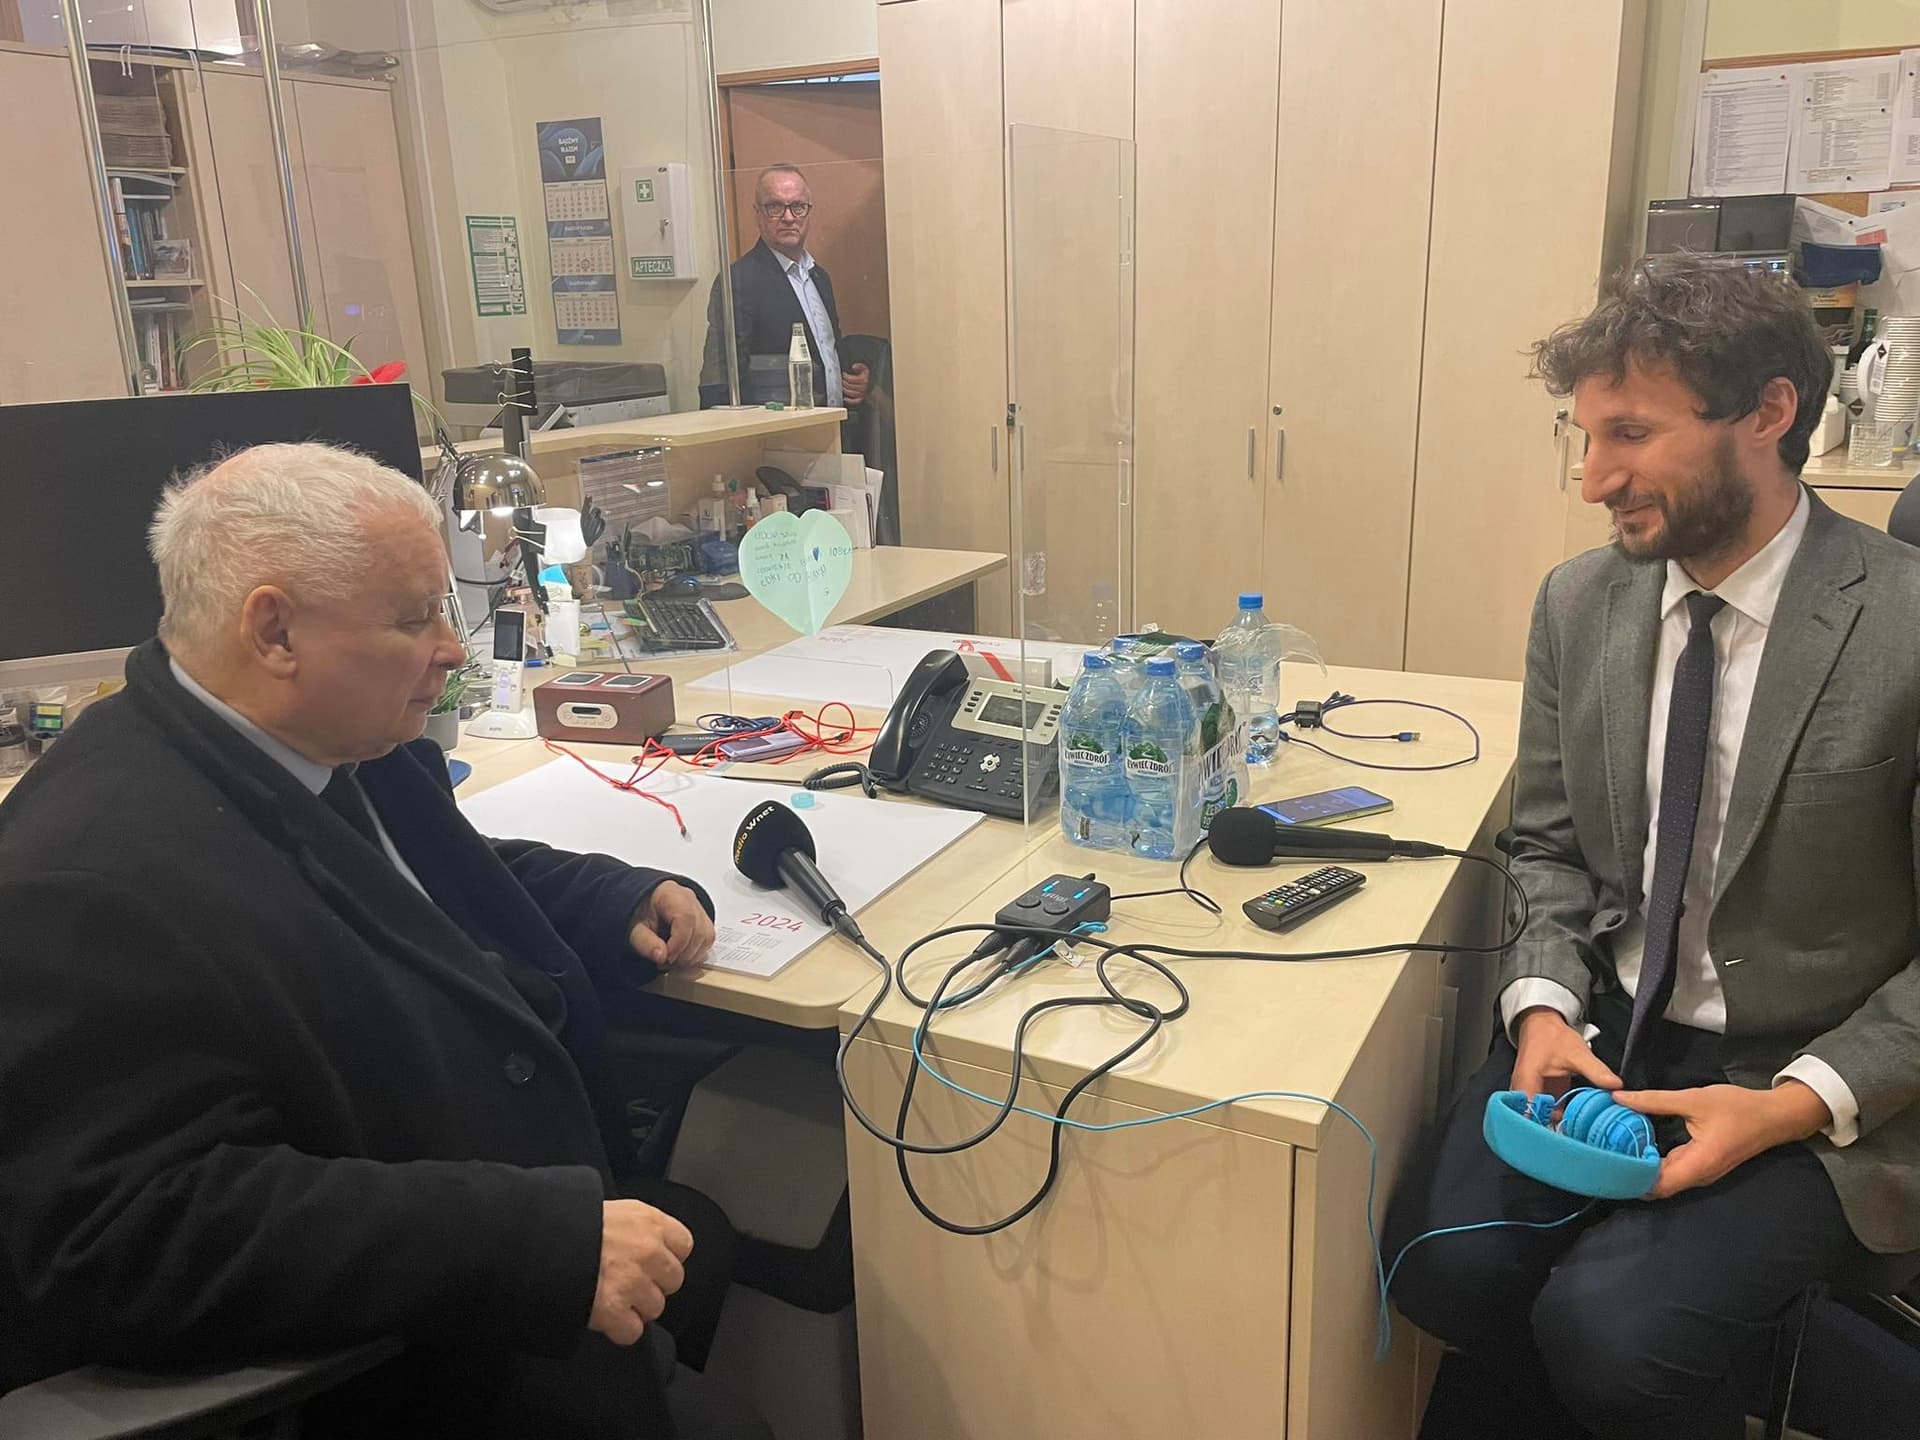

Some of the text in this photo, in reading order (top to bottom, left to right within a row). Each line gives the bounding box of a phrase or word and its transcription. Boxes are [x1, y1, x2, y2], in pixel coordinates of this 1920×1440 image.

[634, 260, 672, 273] APTECZKA
[746, 806, 775, 830] Wnet
[740, 912, 804, 933] 2024
